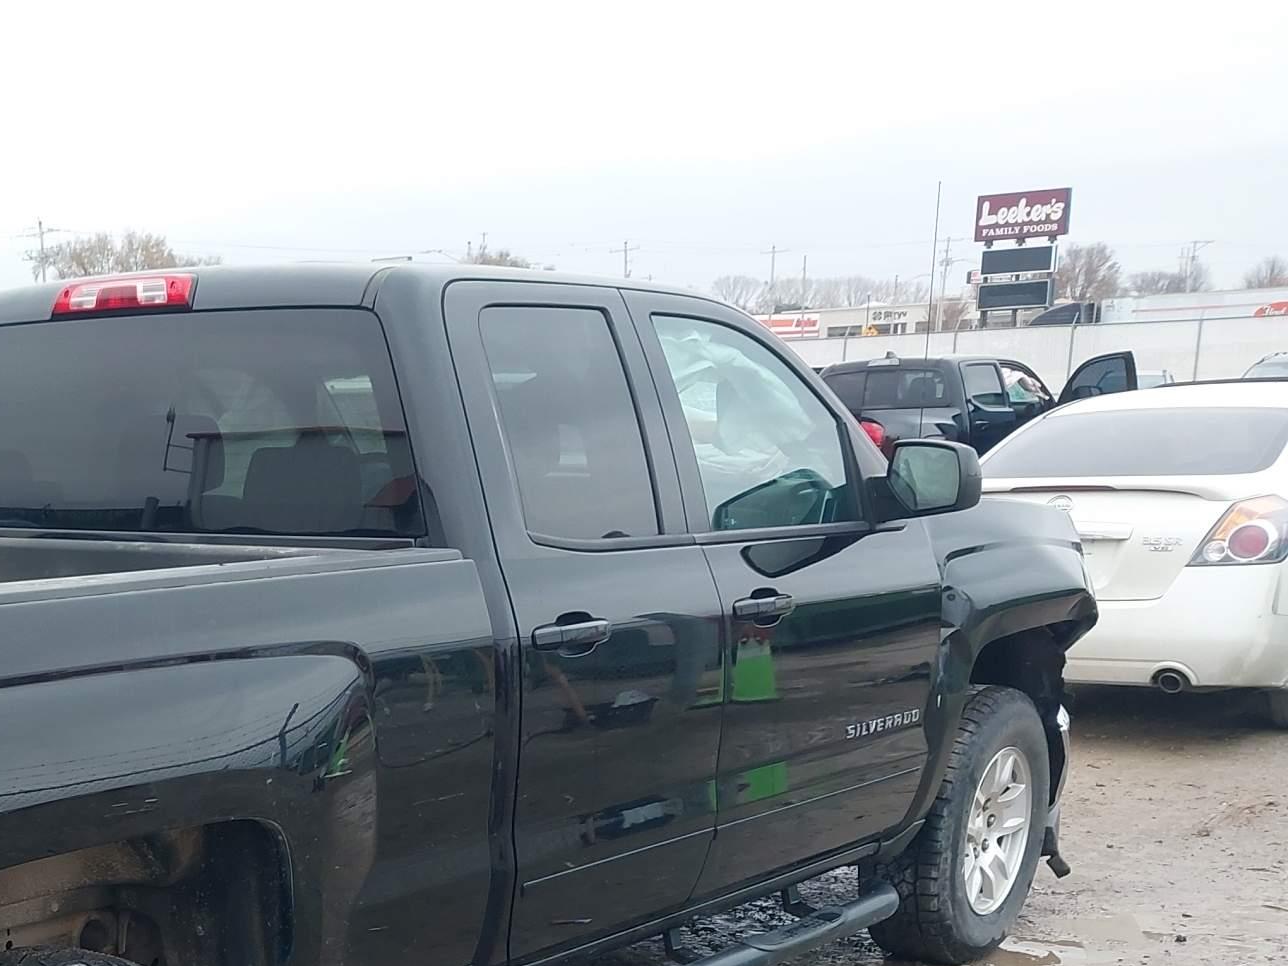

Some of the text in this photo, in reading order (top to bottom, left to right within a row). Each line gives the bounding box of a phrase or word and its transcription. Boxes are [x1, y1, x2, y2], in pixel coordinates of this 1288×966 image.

[979, 198, 1065, 226] Leeker's
[982, 223, 1058, 236] FAMILY FOODS
[845, 708, 920, 739] SILVERADO
